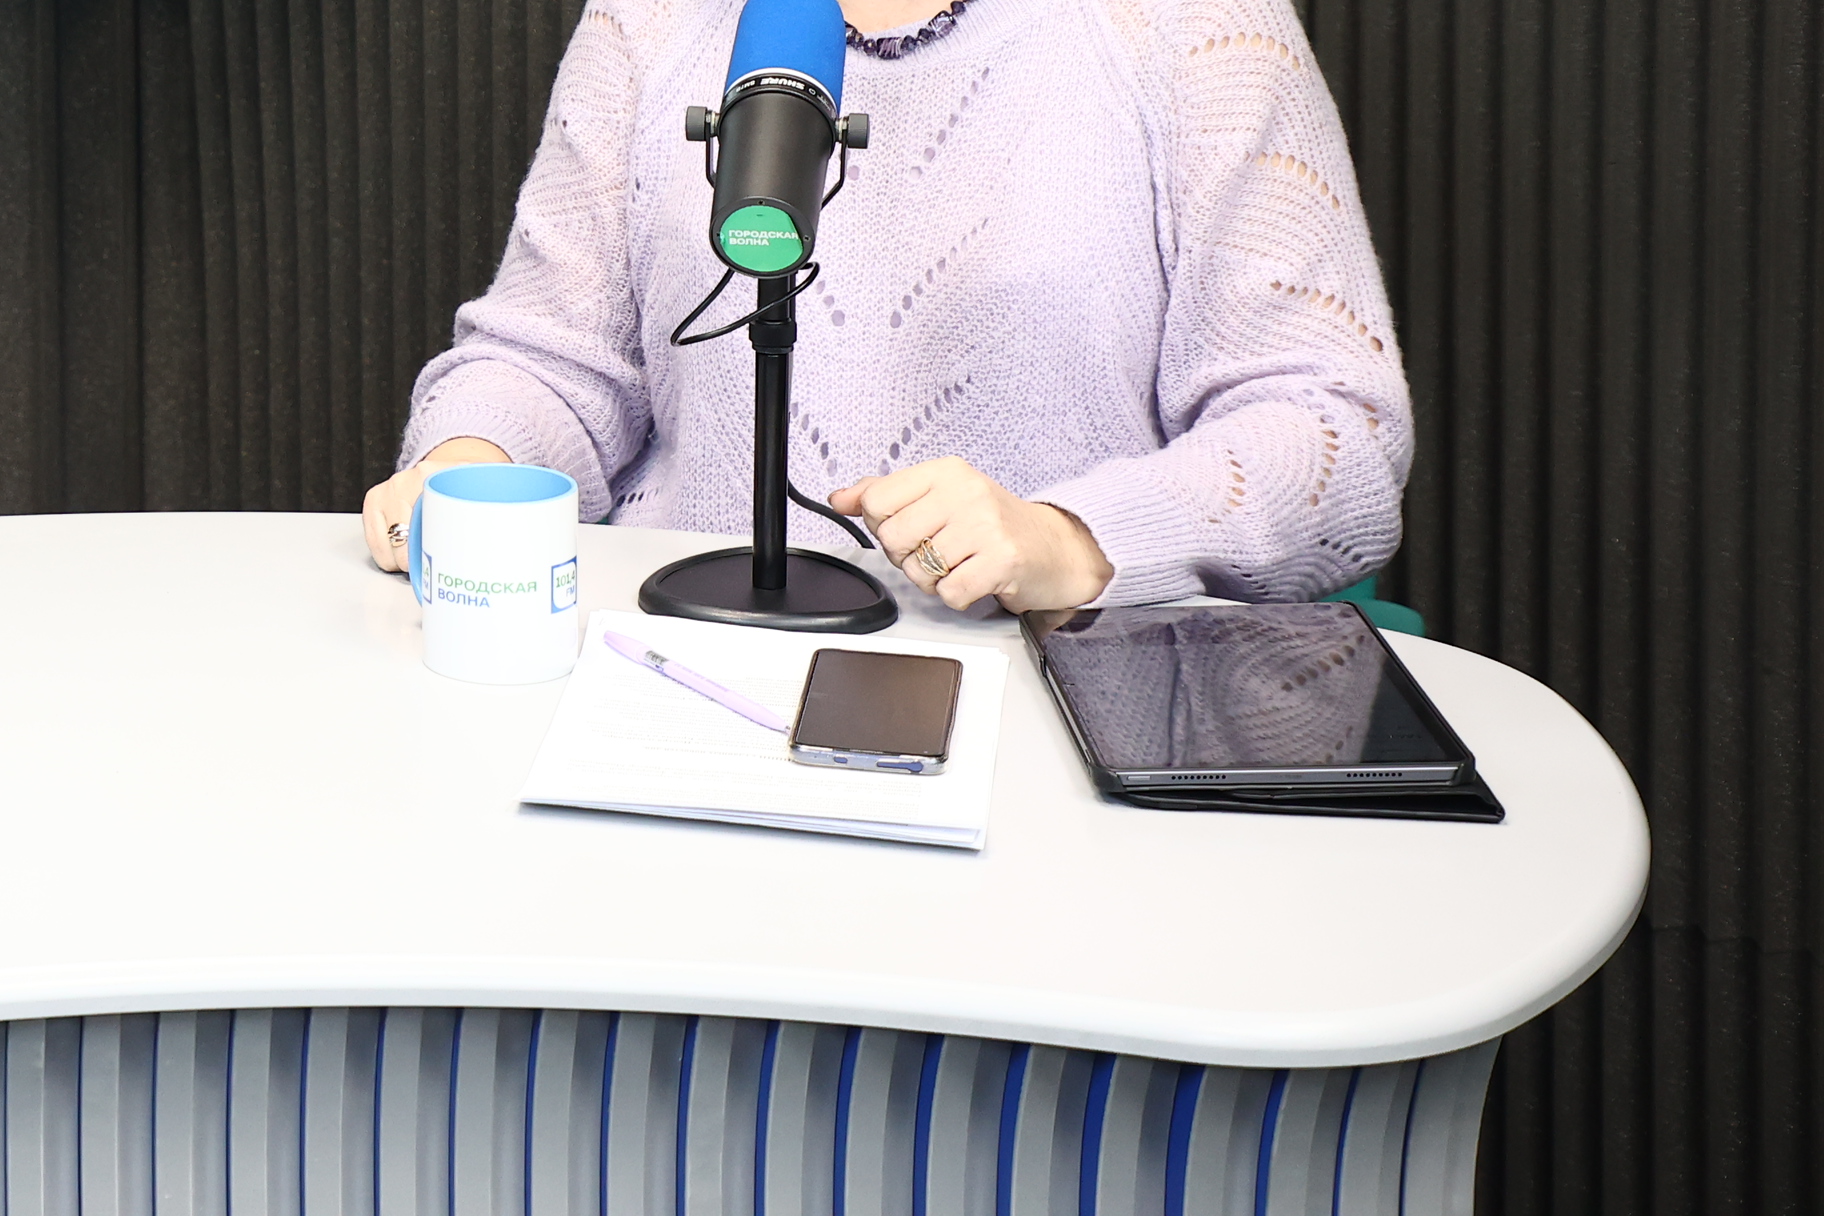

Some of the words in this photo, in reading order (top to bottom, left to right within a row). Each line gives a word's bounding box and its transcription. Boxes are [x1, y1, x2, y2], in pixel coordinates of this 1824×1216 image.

[728, 229, 799, 239] ГОРОДСКАЯ
[729, 238, 770, 246] ВОЛНА
[438, 572, 537, 594] ГОРОДСКАЯ
[438, 587, 490, 607] ВОЛНА
